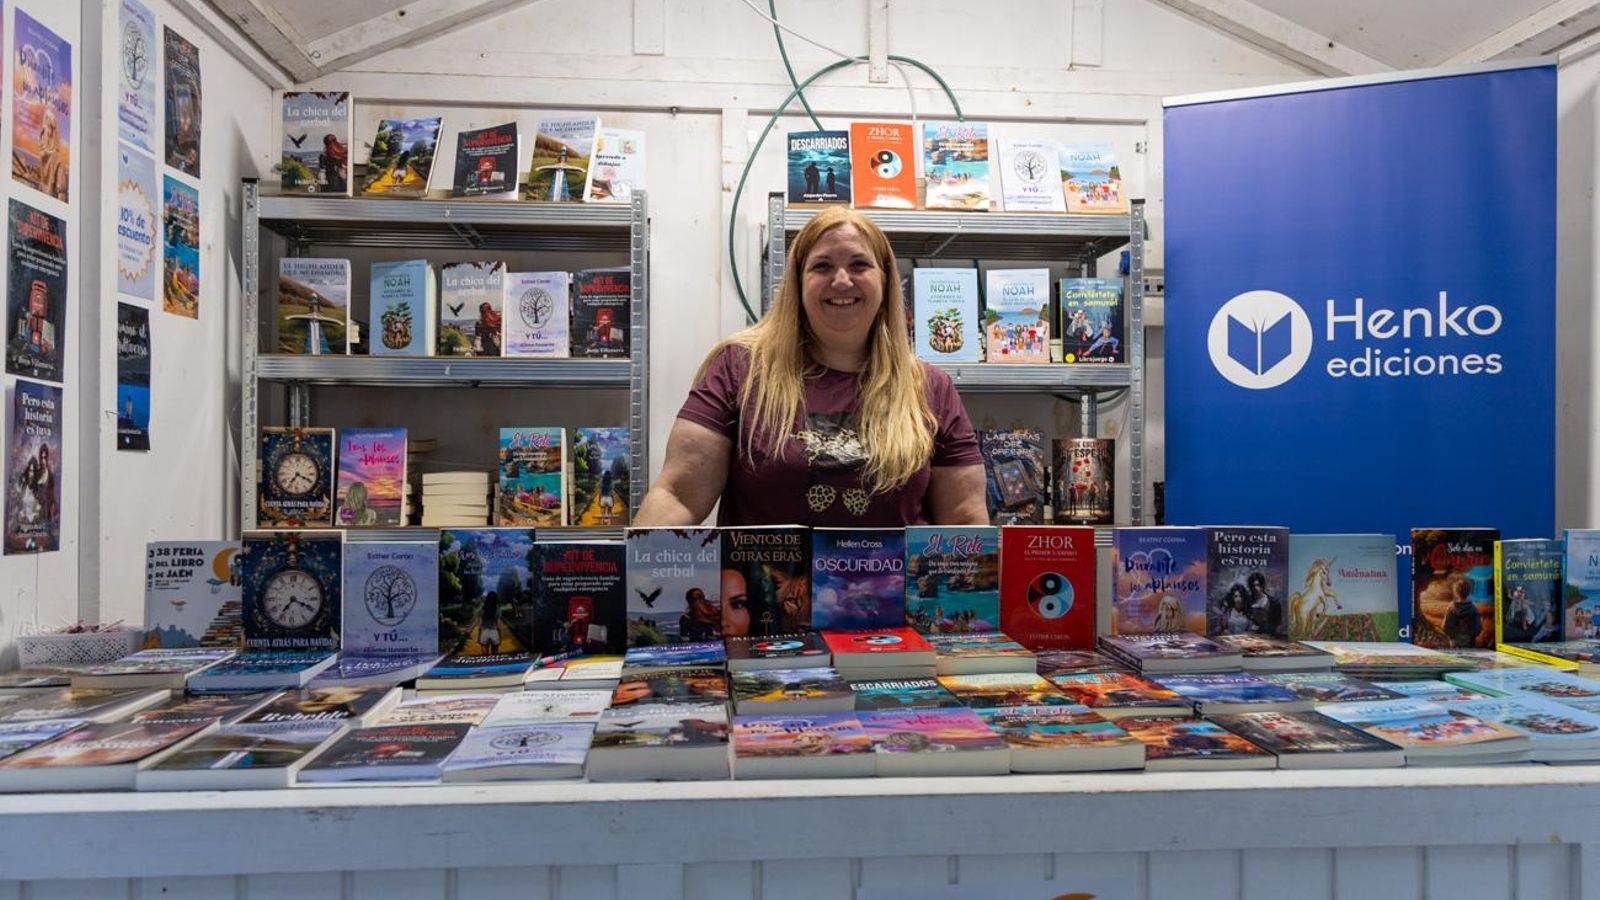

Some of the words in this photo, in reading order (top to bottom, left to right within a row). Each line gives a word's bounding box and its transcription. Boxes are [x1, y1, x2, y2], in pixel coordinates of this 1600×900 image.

[288, 107, 299, 118] La
[303, 107, 328, 118] chica
[331, 106, 346, 117] del
[869, 127, 902, 138] ZHOR
[791, 136, 848, 151] DESCARRIADOS
[1071, 153, 1101, 162] NOAH
[120, 207, 135, 223] 10%
[117, 224, 151, 245] escuento
[384, 277, 411, 287] NOAH
[446, 276, 457, 285] La
[460, 274, 484, 285] chica
[486, 272, 501, 285] del
[930, 284, 961, 293] NOAH
[1002, 287, 1034, 296] NOAH
[1327, 291, 1503, 341] Henko
[1327, 347, 1503, 378] ediciones
[22, 393, 40, 407] Pero
[41, 399, 55, 411] esta
[25, 409, 53, 423] historia
[730, 532, 783, 547] VIENTOS
[785, 534, 801, 545] DE
[1027, 536, 1074, 549] ZHOR
[1214, 531, 1246, 544] Pero
[1250, 532, 1277, 544] esta
[836, 540, 860, 549] Hellen
[862, 540, 884, 549] Cross
[923, 534, 943, 557] El
[947, 534, 984, 558] Reto
[1219, 543, 1272, 555] historia
[156, 548, 170, 556] 38
[173, 547, 204, 556] FERIA
[635, 551, 649, 563] La
[656, 550, 691, 563] chica
[697, 550, 717, 563] del
[730, 551, 771, 562] OTRAS
[773, 550, 803, 562] ERAS
[171, 558, 205, 567] LIBRO
[815, 558, 904, 572] OSCURIDAD
[1221, 558, 1235, 566] es
[1239, 557, 1269, 569] tuya
[652, 564, 695, 577] serbal
[374, 633, 381, 642] Y
[849, 679, 938, 691] ESCARRIADOS
[260, 711, 349, 722] Rebelde
